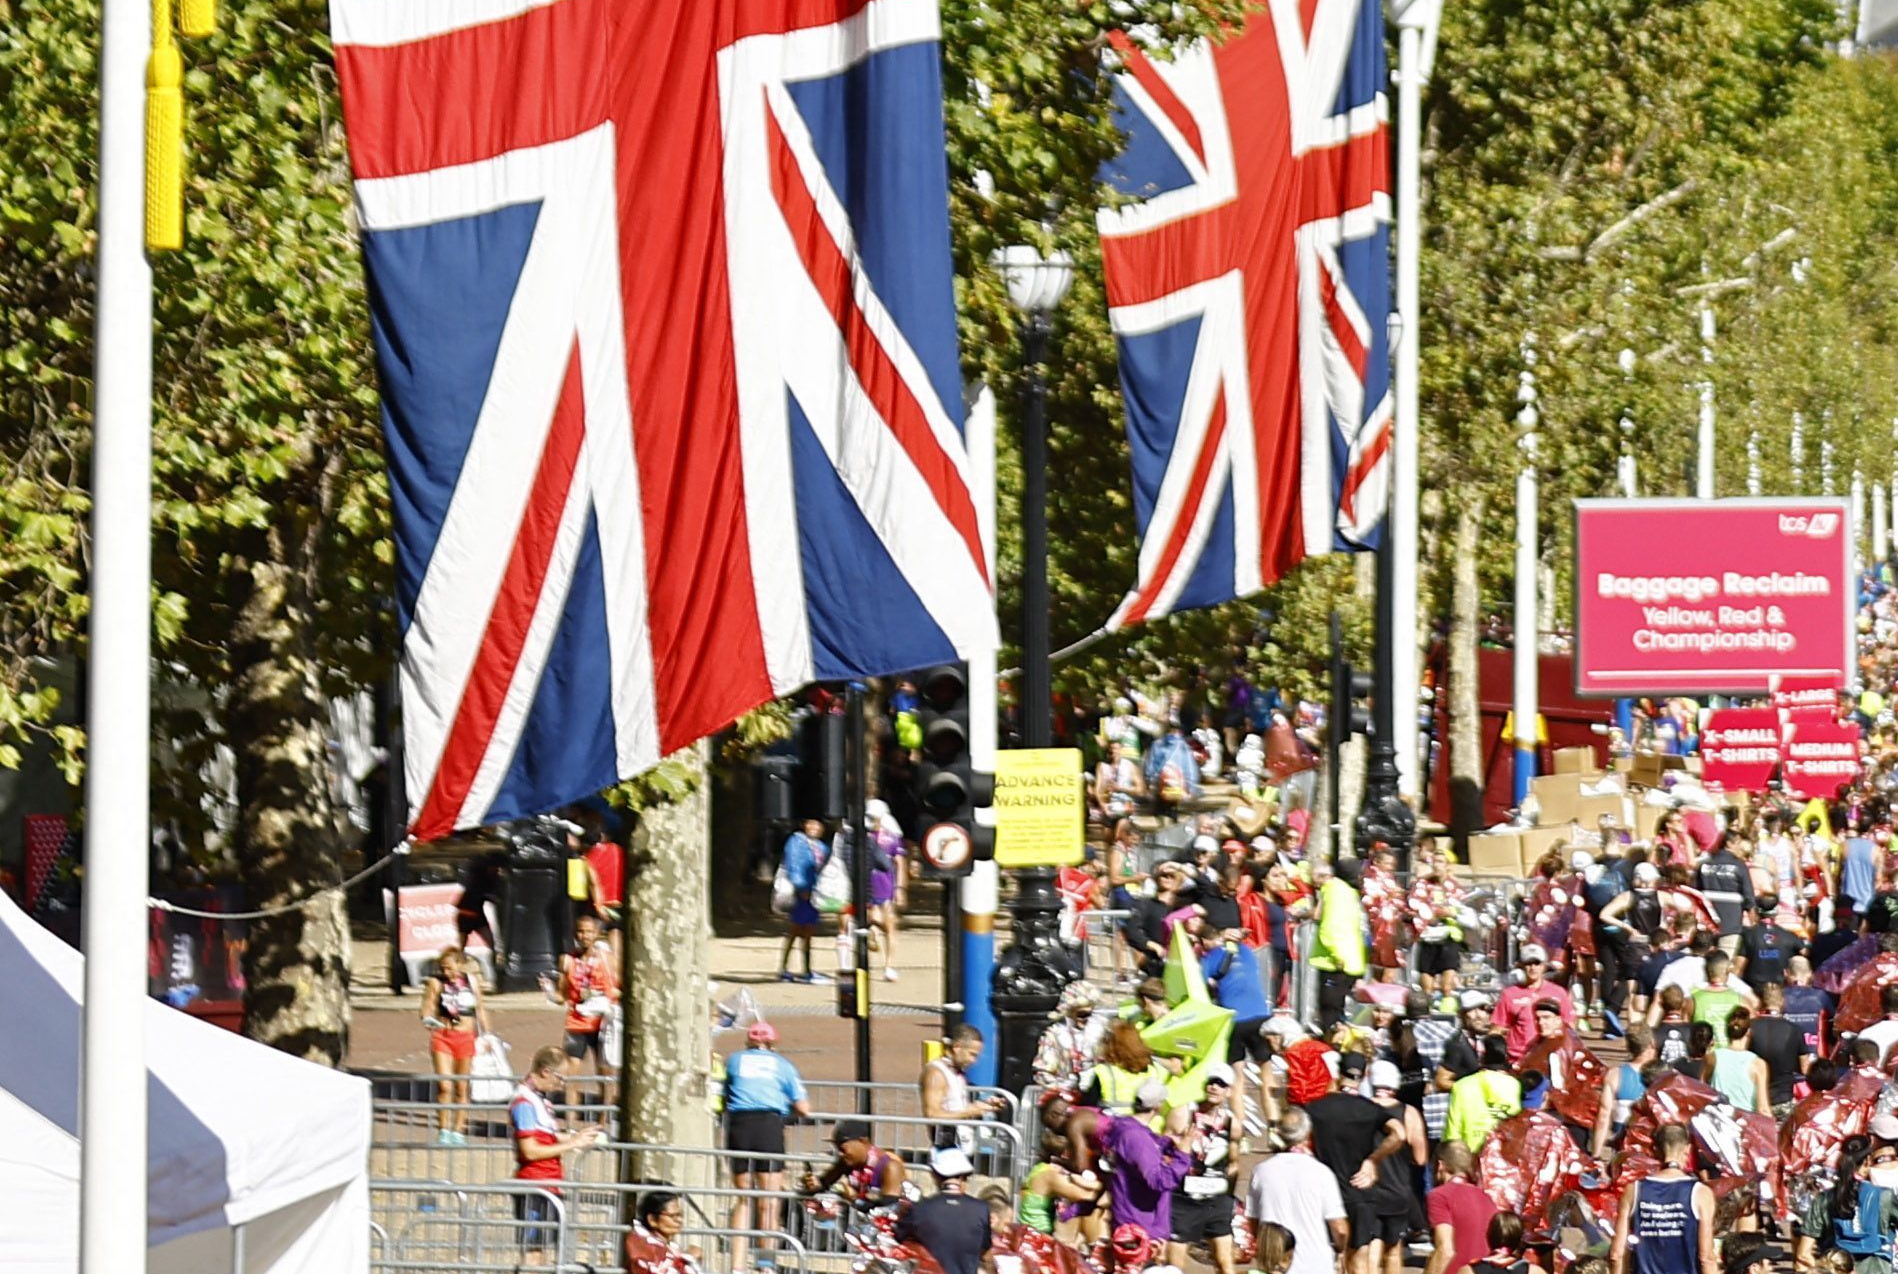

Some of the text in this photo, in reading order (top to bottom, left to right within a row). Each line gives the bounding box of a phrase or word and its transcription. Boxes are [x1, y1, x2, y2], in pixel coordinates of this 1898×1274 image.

[1598, 572, 1829, 602] Baggage Reclaim
[1643, 605, 1787, 627] Yellow, Red &
[1633, 628, 1796, 653] Championship
[1774, 689, 1836, 704] X-LARGE
[1703, 728, 1778, 743] X-SMALL
[1702, 747, 1779, 762] T-SHIRTS
[1789, 742, 1855, 758] MEDIUM
[1785, 760, 1857, 775] T-SHIRTS
[994, 774, 1076, 789] ADVANCE
[993, 794, 1076, 808] WARNING
